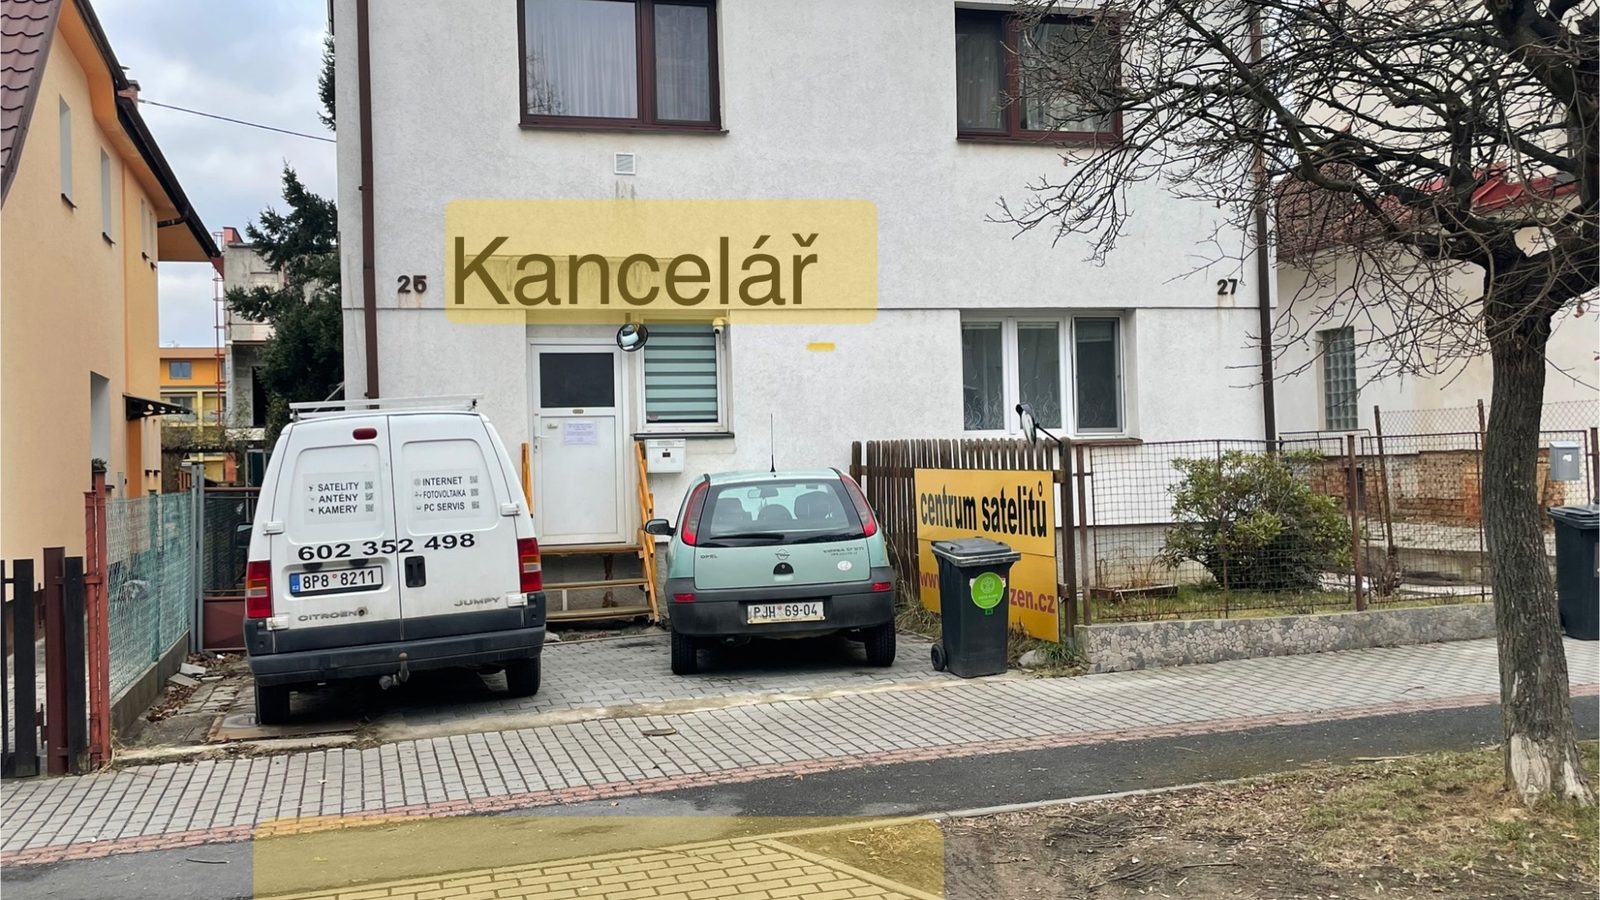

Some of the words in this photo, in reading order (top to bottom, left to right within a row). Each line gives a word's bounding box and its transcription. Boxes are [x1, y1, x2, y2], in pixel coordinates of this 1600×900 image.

[397, 274, 427, 294] 25
[1217, 279, 1238, 295] 27
[422, 476, 463, 486] INTERNET
[318, 482, 359, 492] SATELITY
[423, 489, 466, 499] FOTOVOLTAIKA
[318, 505, 358, 514] KAMERY
[424, 503, 435, 511] PC
[437, 502, 465, 511] SERVIS
[920, 484, 977, 530] centrum
[982, 481, 1047, 537] satelitů
[298, 543, 351, 561] 602
[362, 538, 414, 556] 352
[424, 533, 475, 550] 498
[302, 575, 329, 589] 8P8
[340, 570, 375, 586] 8211
[454, 597, 500, 606] JUMPY
[753, 605, 776, 618] PJH
